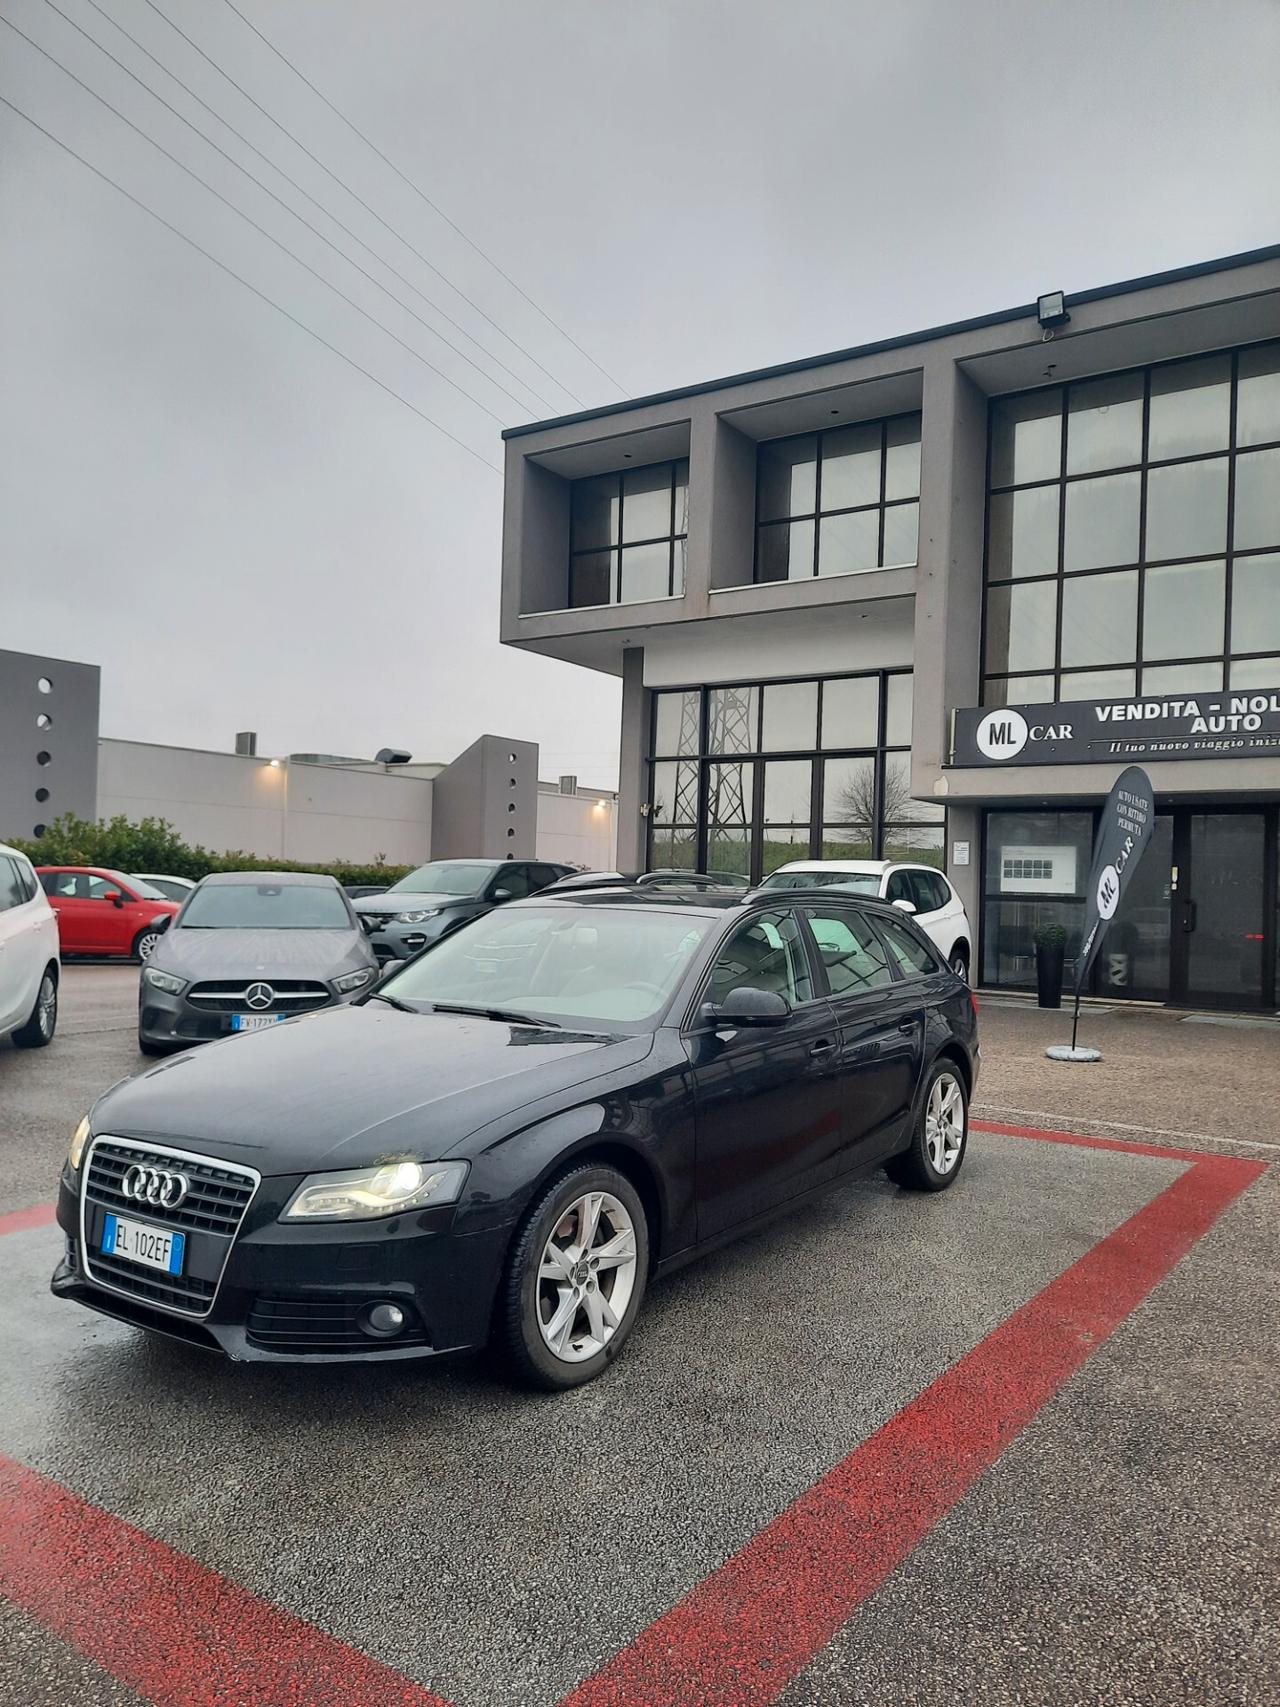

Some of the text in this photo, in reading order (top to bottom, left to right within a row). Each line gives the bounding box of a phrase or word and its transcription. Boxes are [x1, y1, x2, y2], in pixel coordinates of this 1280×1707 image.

[1095, 700, 1201, 722] VENDITA
[1230, 694, 1280, 714] NOL
[988, 721, 1017, 746] ML
[1028, 724, 1074, 741] CAR
[1190, 713, 1263, 734] AUTO
[1109, 742, 1121, 753] Il
[1125, 742, 1146, 752] tuo
[1150, 740, 1190, 751] nuovo
[1193, 737, 1245, 751] viaggio
[1115, 836, 1133, 874] CAR
[116, 1224, 171, 1263] EL 102EF
